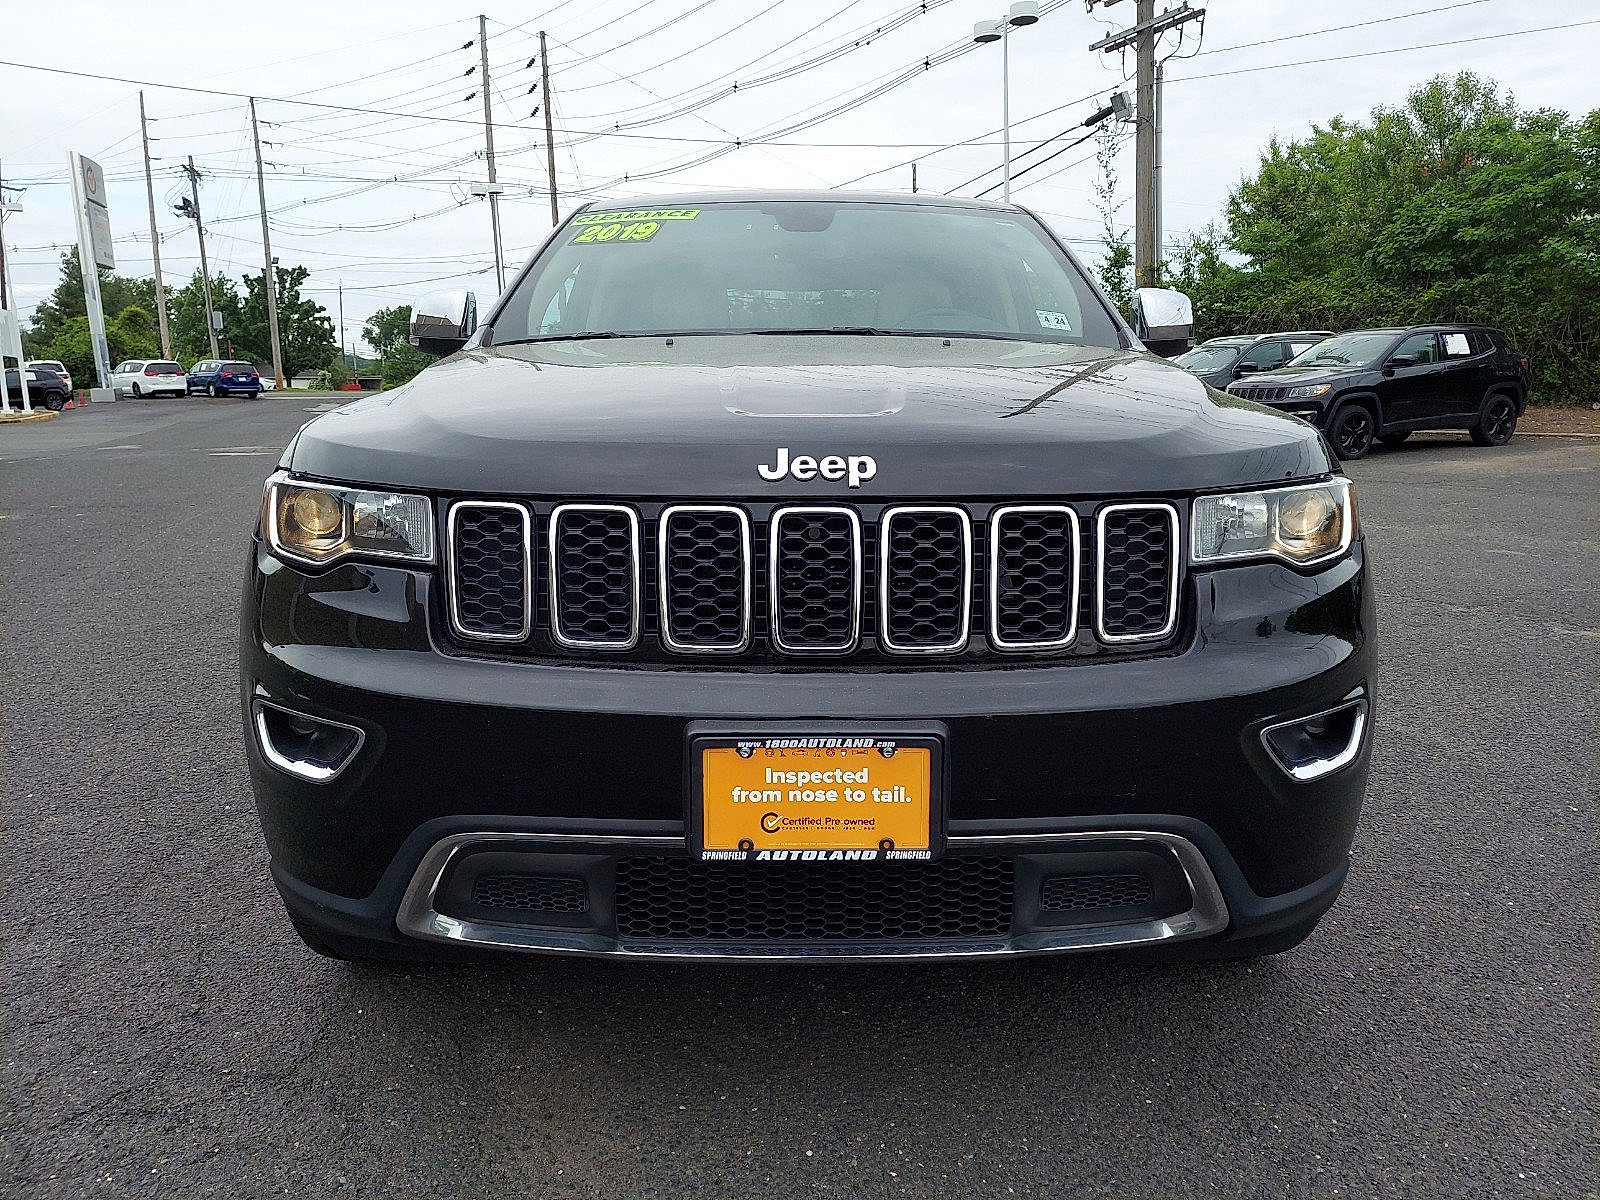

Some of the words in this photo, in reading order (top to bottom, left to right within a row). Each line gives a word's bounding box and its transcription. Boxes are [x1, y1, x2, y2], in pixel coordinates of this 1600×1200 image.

[575, 210, 696, 223] CLEARANCE
[573, 222, 660, 243] 2019
[1055, 317, 1066, 325] 24
[757, 447, 877, 489] Jeep
[737, 739, 895, 748] www.1800AUTOLAND.com
[765, 768, 869, 786] Inspected
[732, 787, 782, 802] from
[788, 790, 838, 802] nose
[844, 788, 865, 802] to
[872, 787, 912, 802] tail.
[782, 817, 821, 825] Certified
[702, 851, 747, 860] SPRINGFIELD
[756, 851, 877, 860] AUTOLAND
[886, 850, 931, 859] SPRINGFIELD
